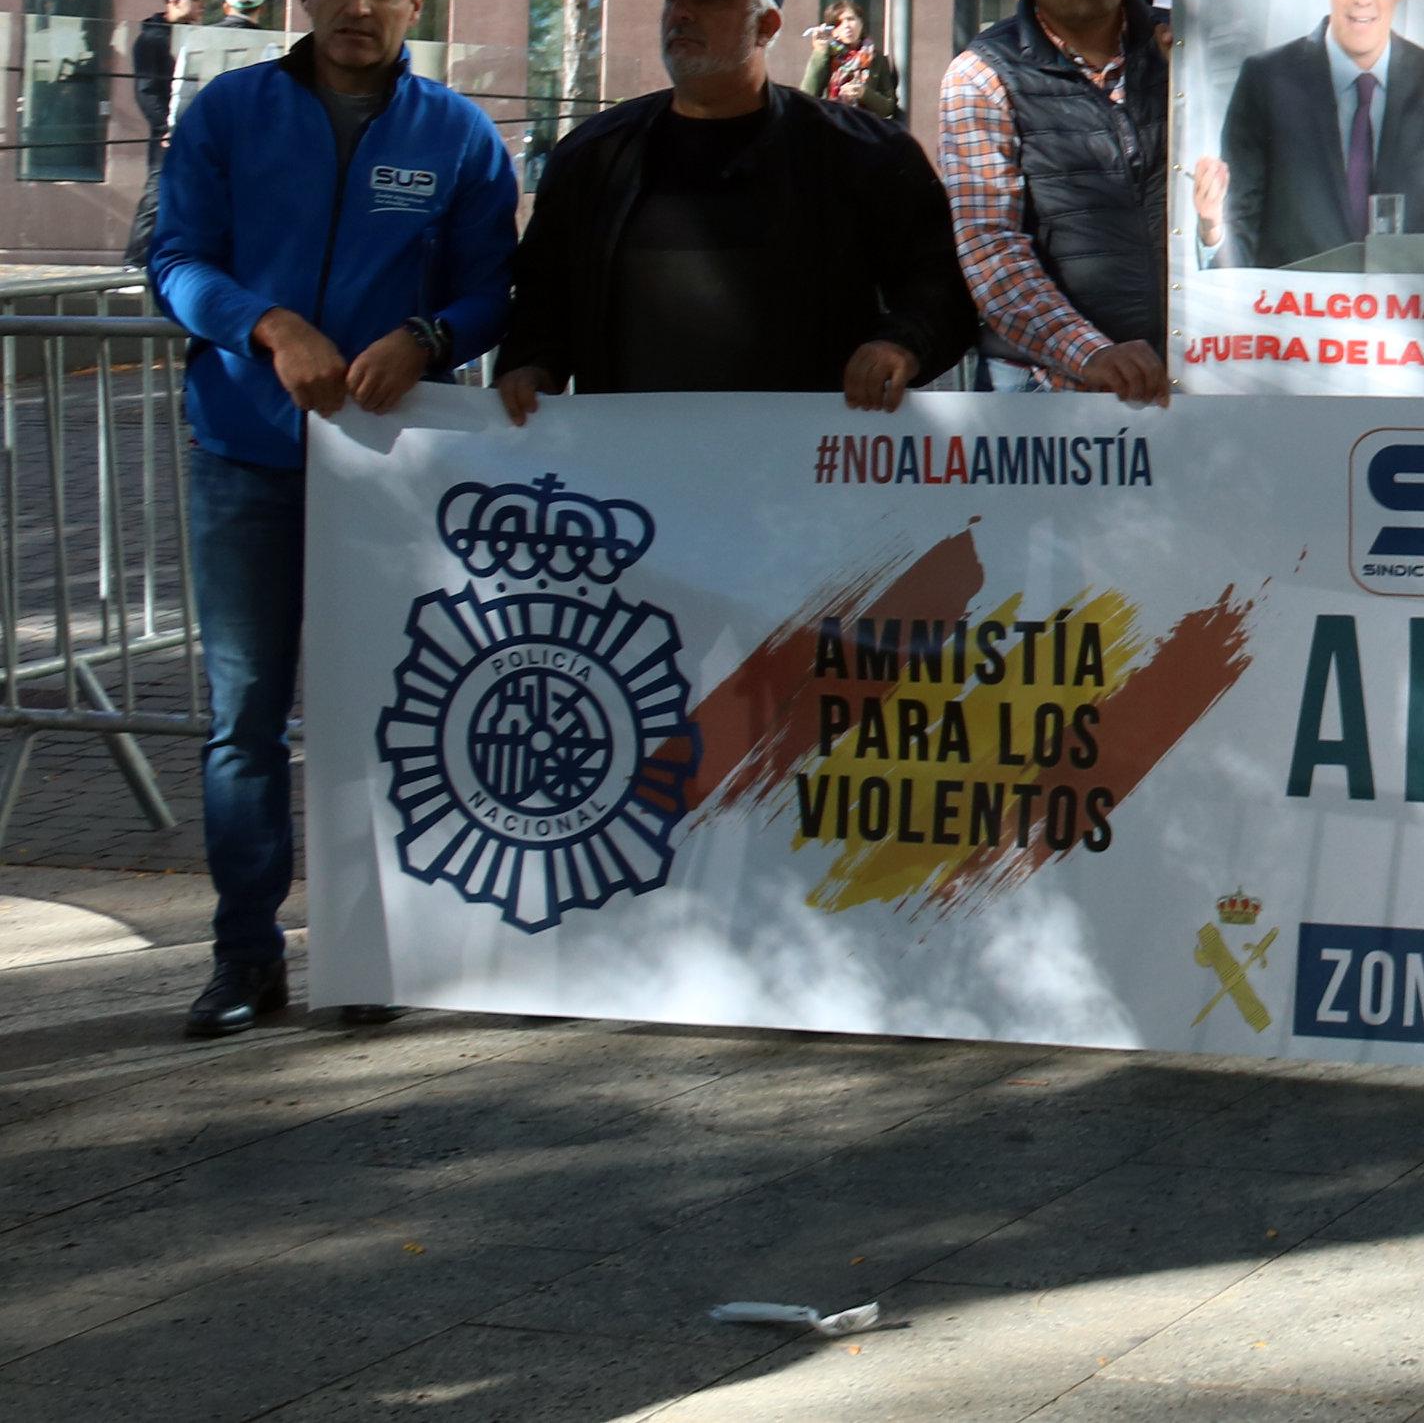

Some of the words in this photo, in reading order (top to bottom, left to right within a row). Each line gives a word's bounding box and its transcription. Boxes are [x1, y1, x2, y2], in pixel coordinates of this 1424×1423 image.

[375, 168, 433, 187] SUP
[1252, 290, 1377, 320] ¿ALGO
[1184, 334, 1310, 365] ¿FUERA
[1318, 338, 1368, 365] DE
[814, 427, 1152, 487] #NOALAAMNISTÍA
[491, 649, 592, 682] POLICÍA
[814, 608, 1106, 688] AMNISTÍA
[818, 694, 971, 765] PARA
[999, 702, 1101, 769] LOS
[467, 789, 608, 838] NACIONAL
[796, 773, 1114, 853] VIOLENTOS
